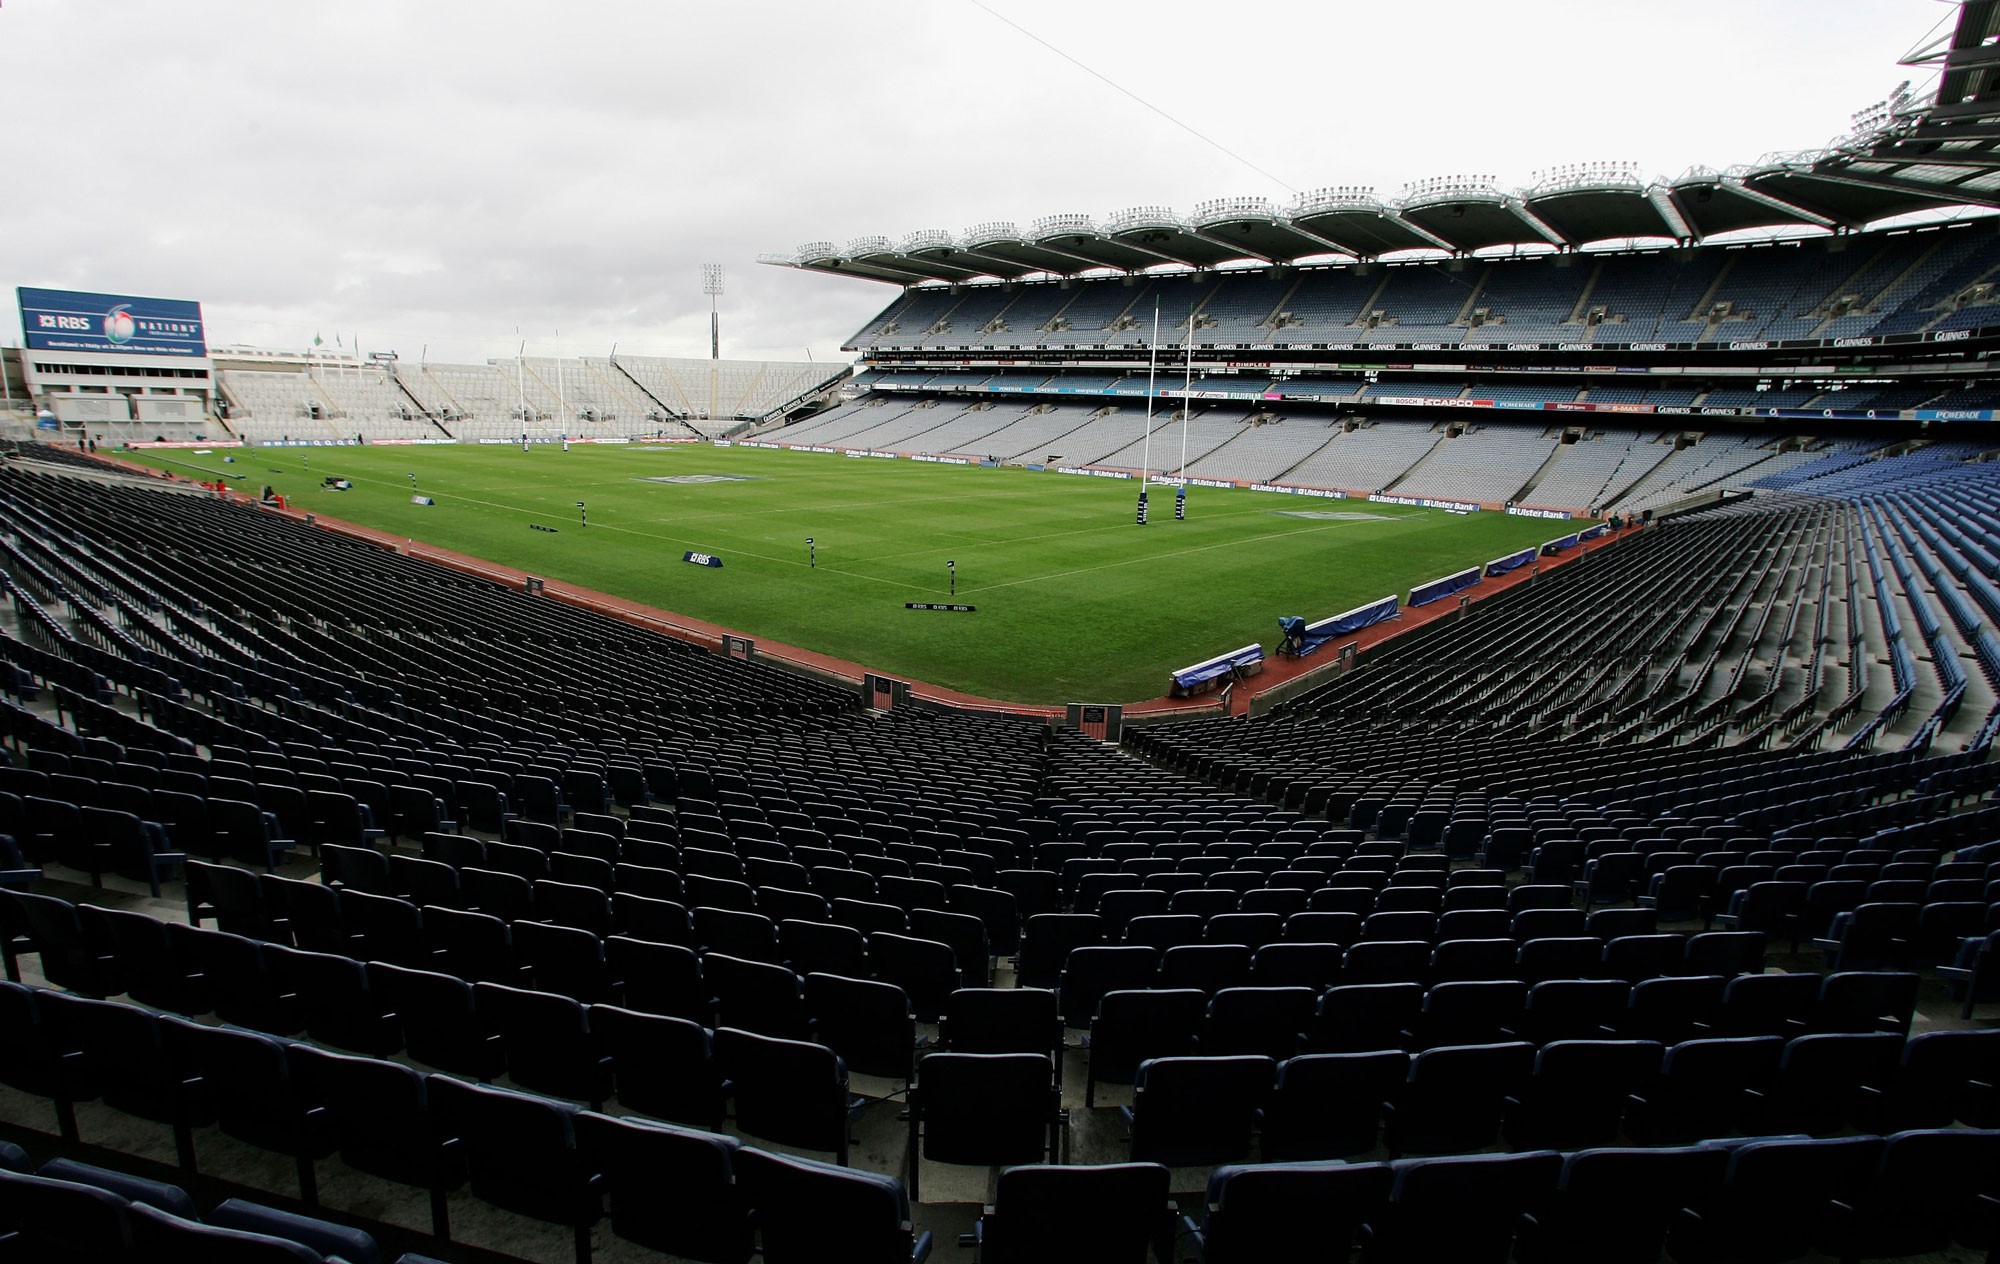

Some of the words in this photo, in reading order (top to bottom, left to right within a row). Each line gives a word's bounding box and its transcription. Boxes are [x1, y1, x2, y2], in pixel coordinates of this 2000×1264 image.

[57, 316, 91, 330] RBS
[139, 322, 194, 333] NATIONS
[1935, 330, 1970, 341] GUINNESS
[86, 342, 100, 350] Italy
[1630, 342, 1666, 350] GUINNESS
[1729, 340, 1768, 350] GUINNESS
[1834, 337, 1872, 347] GUINNESS
[1231, 392, 1261, 400] FUJIFILM
[1658, 406, 1691, 414] GUINNESS
[1701, 407, 1735, 415] GUINNESS
[1936, 411, 1981, 419] POWERADE
[1062, 467, 1077, 475] Ulster
[1077, 468, 1090, 476] Bank
[1198, 478, 1214, 486] Ulster
[1257, 484, 1276, 493] Ulster
[1276, 486, 1292, 494] Bank
[1304, 488, 1324, 497] Ulster
[1376, 494, 1398, 503] Ulster
[1399, 496, 1417, 505] Bank
[1430, 499, 1454, 509] Ulster
[1455, 502, 1474, 511] Bank
[1517, 506, 1542, 518] Ulster
[1543, 509, 1564, 519] Bank
[696, 553, 711, 566] RBS
